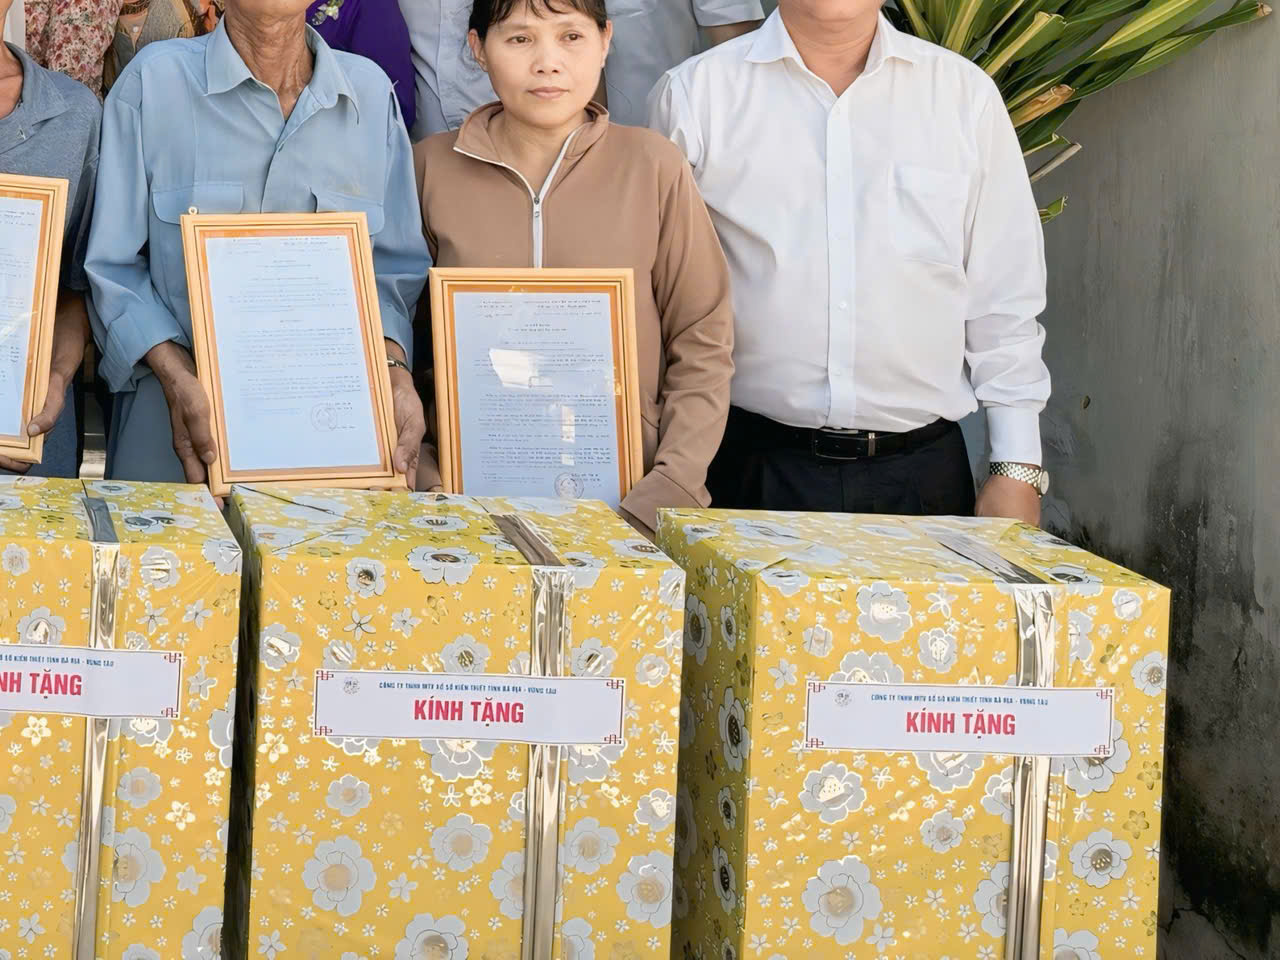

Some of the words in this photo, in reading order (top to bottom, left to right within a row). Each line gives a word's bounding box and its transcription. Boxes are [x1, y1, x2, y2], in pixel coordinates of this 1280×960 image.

[29, 668, 82, 699] TẶNG
[414, 696, 464, 721] KÍNH
[470, 697, 524, 727] TẶNG
[906, 707, 956, 733] KÍNH
[962, 708, 1016, 739] TẶNG
